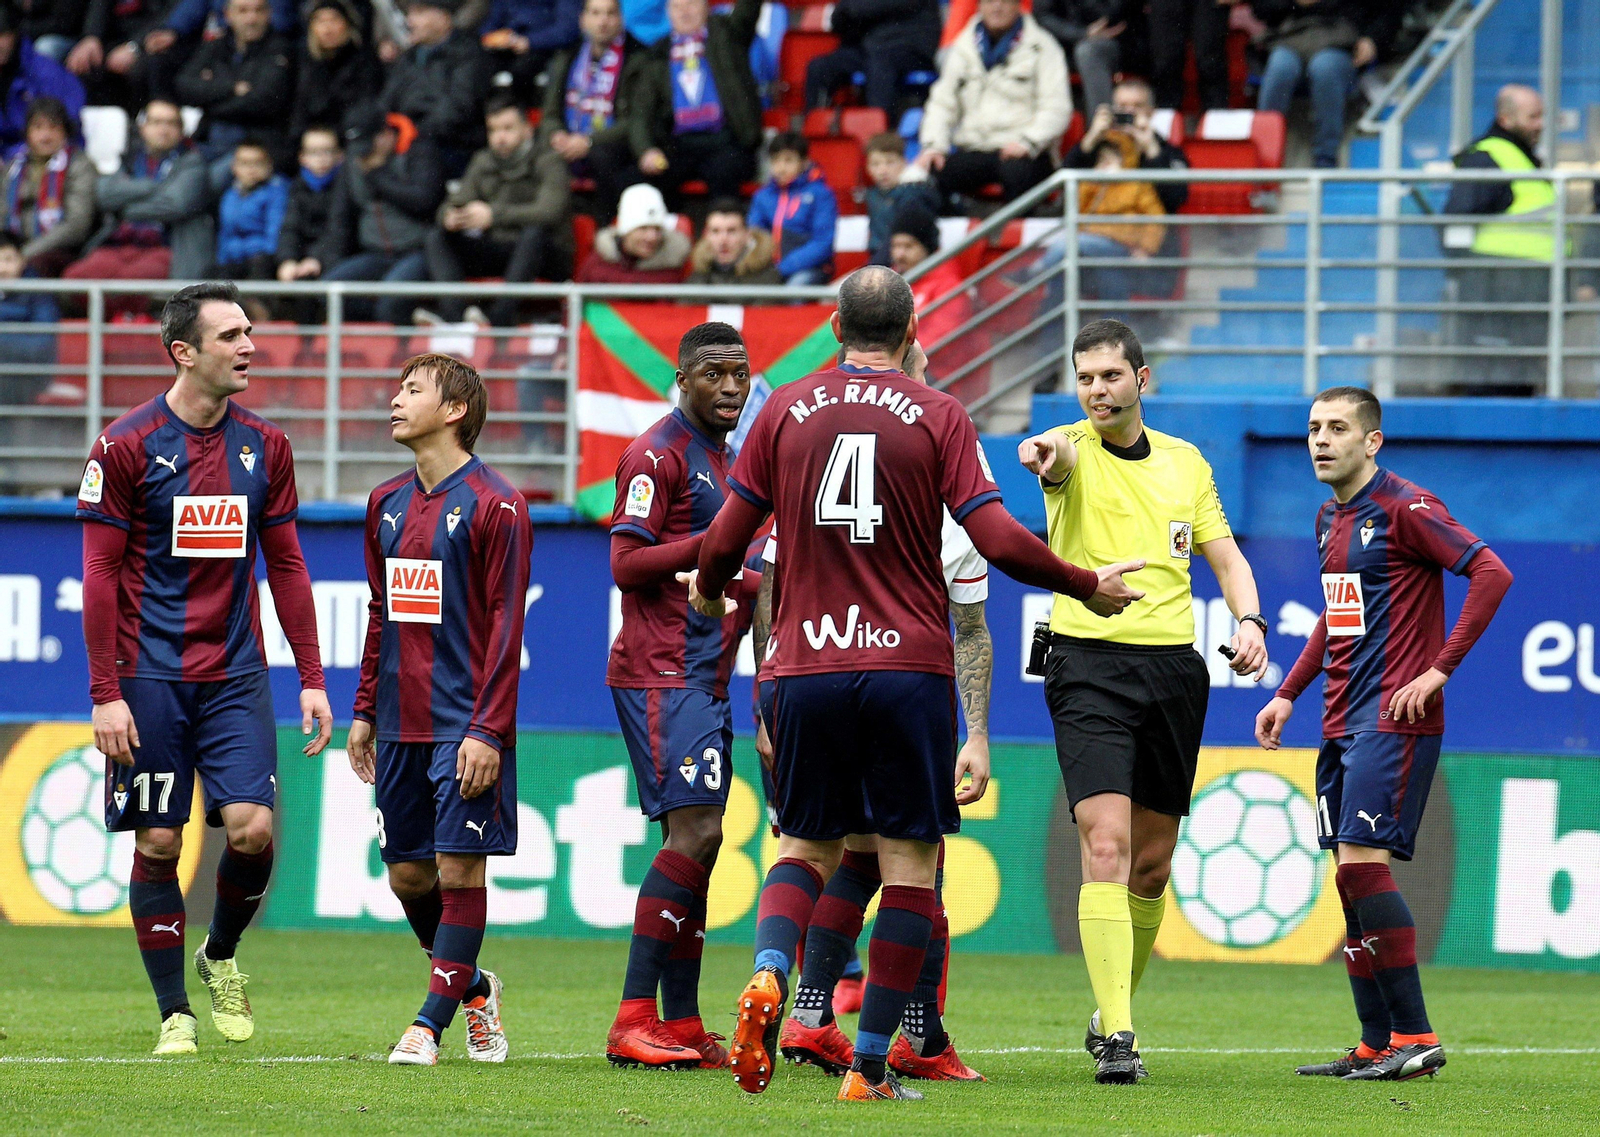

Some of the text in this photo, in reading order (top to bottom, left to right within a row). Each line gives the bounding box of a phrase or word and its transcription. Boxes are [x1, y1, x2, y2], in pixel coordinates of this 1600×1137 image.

[788, 384, 924, 425] N.E. RAMIS
[814, 432, 883, 544] 4
[802, 604, 901, 650] Wiko
[703, 747, 722, 790] 3
[133, 772, 175, 813] 17
